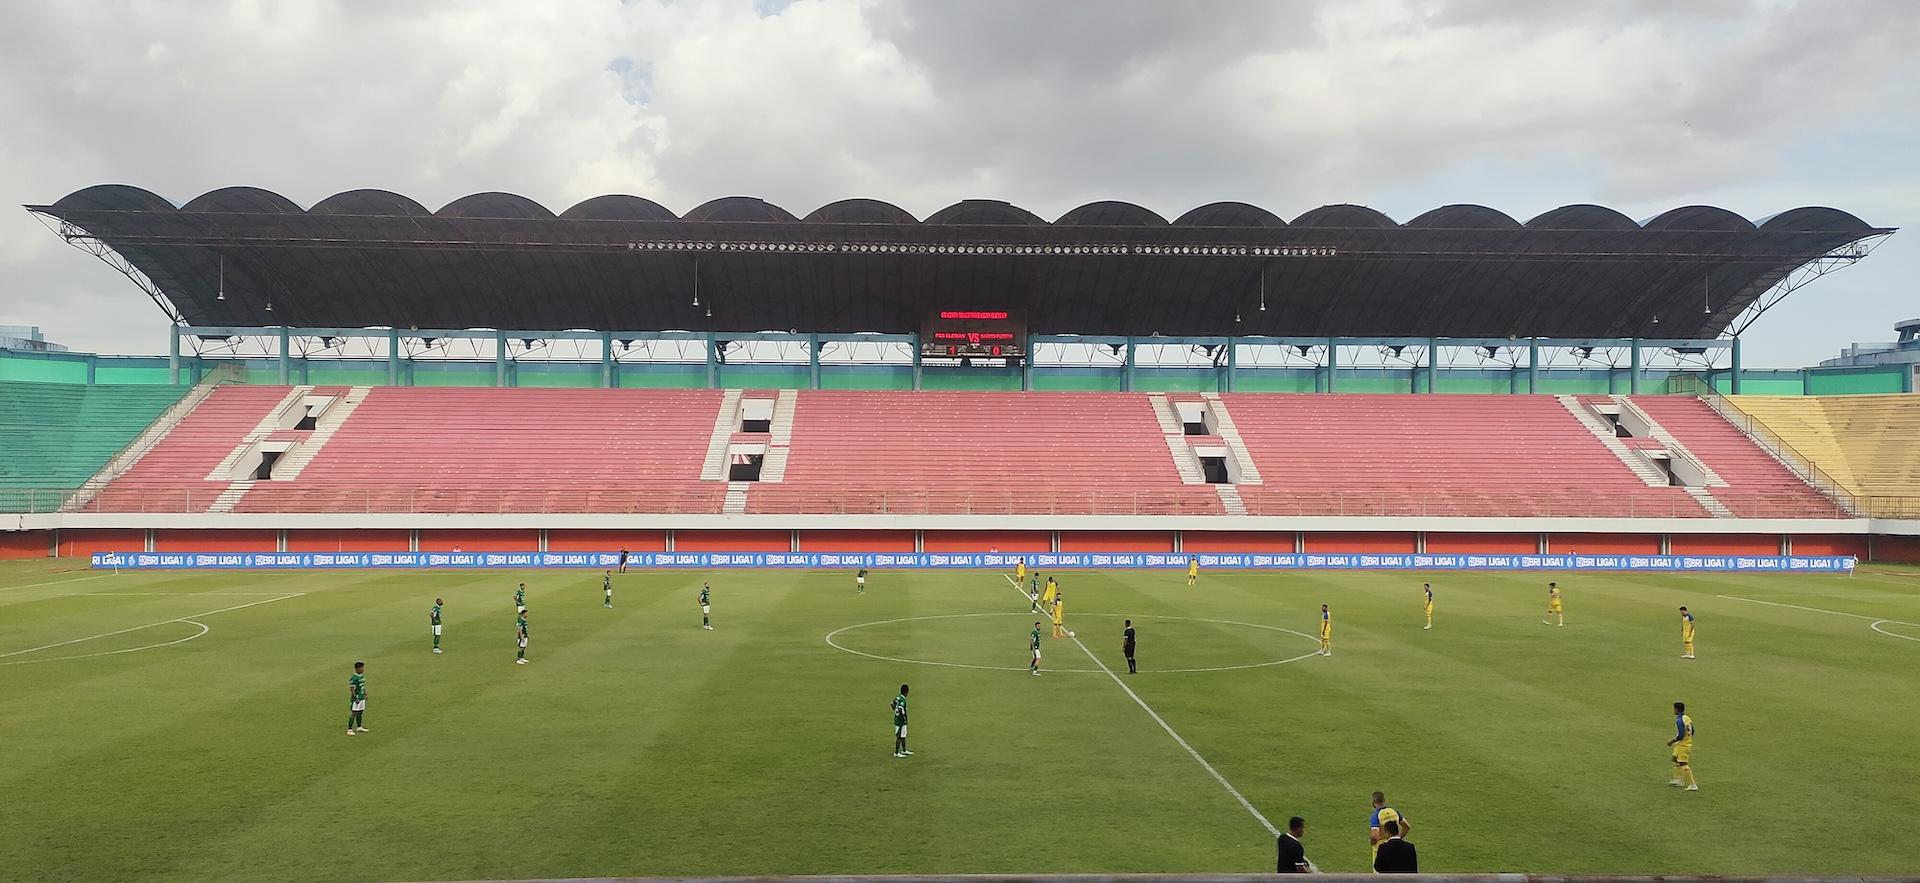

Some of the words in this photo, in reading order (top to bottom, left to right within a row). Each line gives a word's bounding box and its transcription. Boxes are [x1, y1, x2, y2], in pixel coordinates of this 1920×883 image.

[968, 332, 980, 342] VS
[950, 346, 955, 355] 1
[993, 346, 1000, 355] 0
[92, 556, 100, 565] RI
[147, 556, 158, 565] BRI
[161, 556, 183, 565] LIGA1
[206, 556, 217, 565] BRI
[219, 556, 241, 565] LIGA1
[264, 555, 275, 564] BRI
[277, 555, 300, 564] LIGA1
[322, 555, 333, 564] BRI
[336, 555, 358, 564] LIGA1
[381, 555, 392, 564] BRI
[394, 555, 416, 564] LIGA1
[438, 555, 449, 564] BRI
[451, 555, 473, 564] LIGA1
[495, 555, 506, 564] BRI
[509, 555, 530, 564] LIGA1
[552, 555, 563, 564] BRI
[565, 555, 586, 564] LIGA1
[608, 555, 618, 564] BRI
[627, 555, 642, 564] GA1
[664, 555, 674, 564] BRI
[677, 555, 698, 564] LIGA1
[719, 555, 730, 564] BRI
[732, 555, 753, 564] LIGA1
[774, 555, 785, 564] BRI
[787, 555, 808, 564] LIGA1
[829, 555, 840, 564] BRI
[842, 555, 862, 564] LIGA1
[884, 555, 894, 564] BRI
[896, 555, 917, 564] LIGA1
[938, 555, 949, 564] BRI
[951, 555, 971, 564] LIGA1
[993, 555, 1003, 564] BRI
[1047, 555, 1057, 564] BRI
[1059, 555, 1079, 564] LIGA1
[1100, 556, 1111, 564] BRI
[1113, 556, 1133, 564] LIGA1
[1154, 556, 1165, 565] BRI
[1167, 556, 1187, 565] LIGA1
[1208, 556, 1218, 565] BRI
[1220, 556, 1241, 565] LIGA1
[1262, 556, 1272, 565] BRI
[1274, 556, 1294, 565] LIGA1
[1315, 557, 1325, 565] BRI
[1328, 557, 1348, 565] LIGA1
[1369, 557, 1379, 566] BRI
[1381, 557, 1402, 566] LIGA1
[1423, 557, 1433, 566] BRI
[1435, 557, 1455, 566] LIGA1
[1476, 557, 1486, 566] BRI
[1489, 557, 1509, 566] LIGA1
[1530, 558, 1540, 566] BRI
[1543, 558, 1563, 566] LIGA1
[1584, 558, 1595, 567] BRI
[1597, 558, 1617, 567] LIGA1
[1638, 558, 1649, 567] BRI
[1651, 558, 1671, 567] LIGA1
[1692, 558, 1702, 567] BRI
[1704, 558, 1725, 567] LIGA1
[1745, 559, 1755, 567] BRI
[1758, 559, 1777, 568] LIGA1
[1798, 559, 1808, 568] BRI
[1810, 559, 1830, 568] LIGA1
